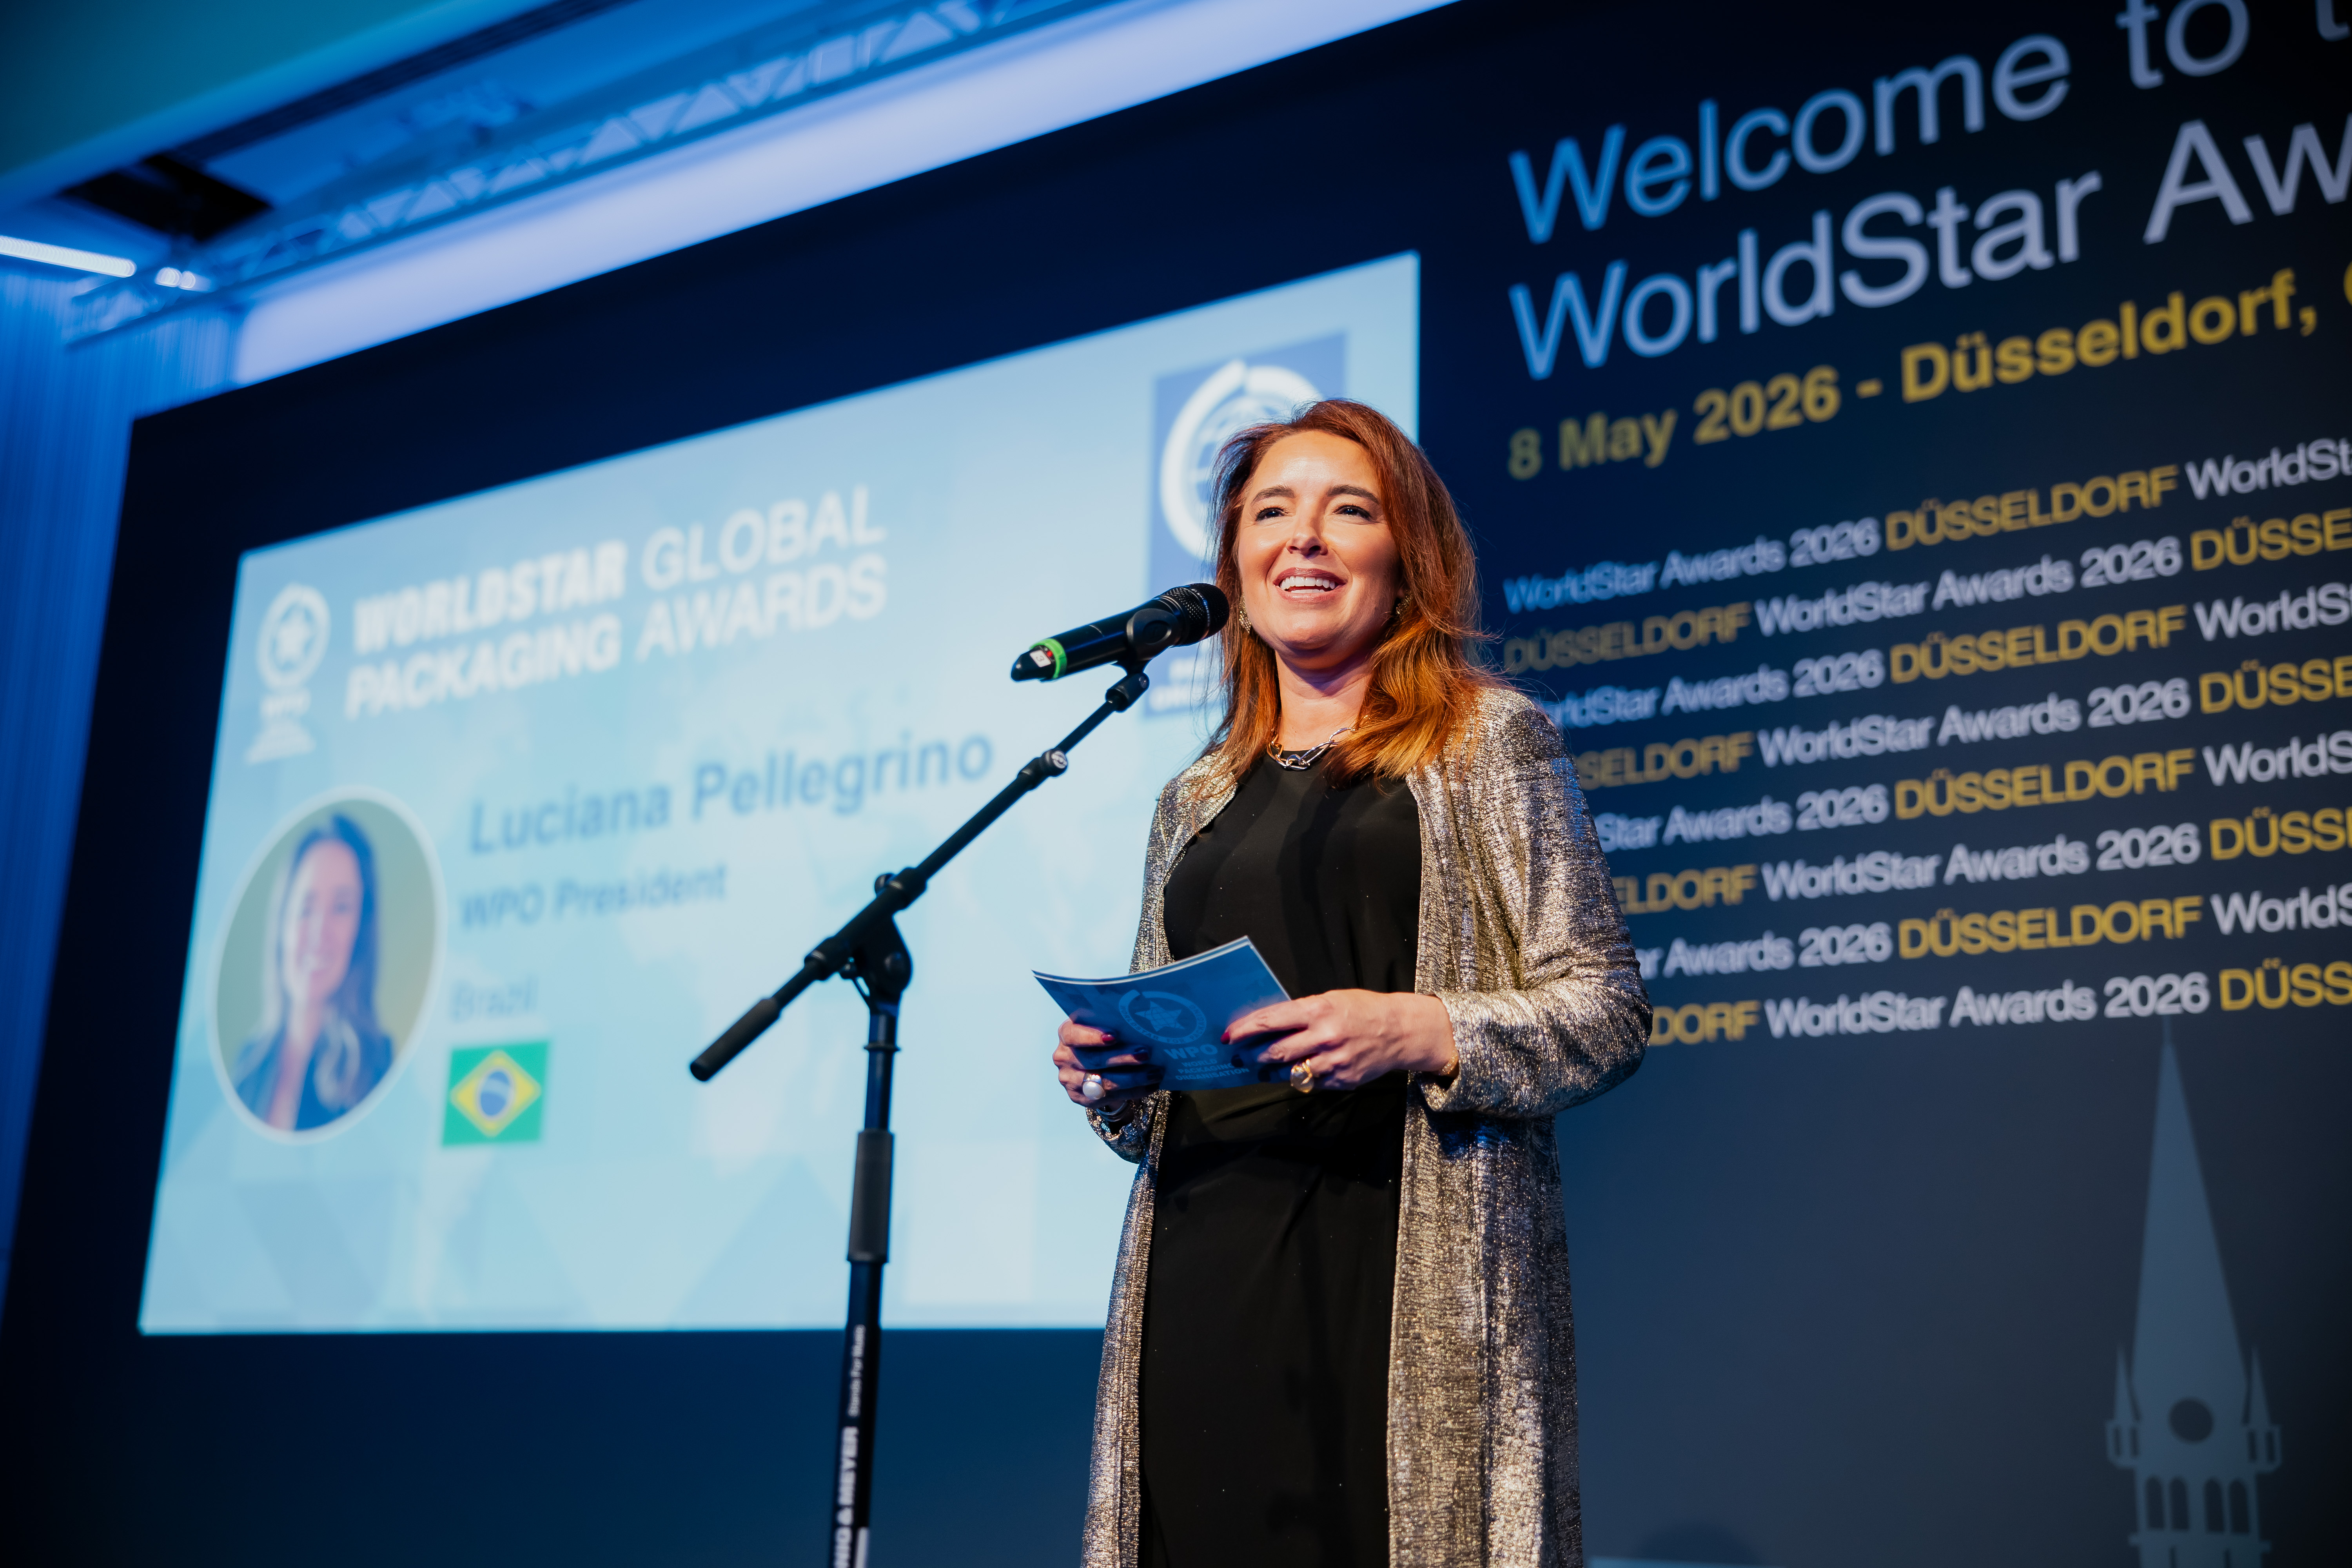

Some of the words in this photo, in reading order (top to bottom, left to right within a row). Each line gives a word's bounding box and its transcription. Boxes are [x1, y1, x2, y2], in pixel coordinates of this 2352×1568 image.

[1509, 34, 2071, 244] Welcome
[2115, 0, 2249, 89] to
[1509, 171, 2102, 380] WorldStar
[1508, 428, 1542, 480] 8
[1559, 410, 1677, 469] May
[1694, 366, 1841, 445] 2026
[1901, 269, 2317, 403] Düsseldorf,
[354, 541, 626, 655] WORLDSTAR
[642, 484, 887, 588] GLOBAL
[1503, 561, 1661, 613] WorldStar
[1660, 537, 1787, 589] Awards
[1789, 517, 1881, 567] 2026
[1885, 465, 2179, 551] DÜSSELDORF
[2185, 437, 2352, 500] WorldSt
[344, 612, 622, 719] PACKAGING
[635, 555, 889, 659] AWARDS
[1504, 602, 1752, 675] DÜSSELDORF
[1754, 580, 1931, 637] WorldStar
[1931, 555, 2075, 610] Awards
[2080, 537, 2183, 588] 2026
[1661, 665, 1790, 715] Awards
[1792, 649, 1886, 697] 2026
[1890, 605, 2187, 684] DÜSSELDORF
[2193, 582, 2352, 641] WorldS
[469, 782, 670, 855] Luciana
[691, 730, 994, 821] Pellegrino
[1575, 731, 1754, 790] SELDORF
[1757, 713, 1936, 768] WorldStar
[1936, 693, 2082, 746] Awards
[2087, 677, 2191, 728] 2026
[1662, 797, 1792, 845] Awards
[1796, 784, 1890, 831] 2026
[1895, 748, 2195, 820] DÜSSELDORF
[1760, 849, 1941, 902] WorldStar
[1943, 835, 2091, 885] Awards
[2096, 822, 2201, 871] 2026
[2209, 806, 2352, 860] DÜSS
[459, 876, 544, 933] WPO
[554, 862, 728, 920] President
[1662, 931, 1795, 977] Awards
[1798, 922, 1893, 967] 2026
[1898, 895, 2203, 959] DÜSSELDORF
[1163, 1044, 1218, 1059] WPO
[1764, 989, 1945, 1038] WorldStar
[1949, 979, 2098, 1028] Awards
[2103, 971, 2211, 1018] 2026
[1176, 1068, 1250, 1080] ORGANISATION
